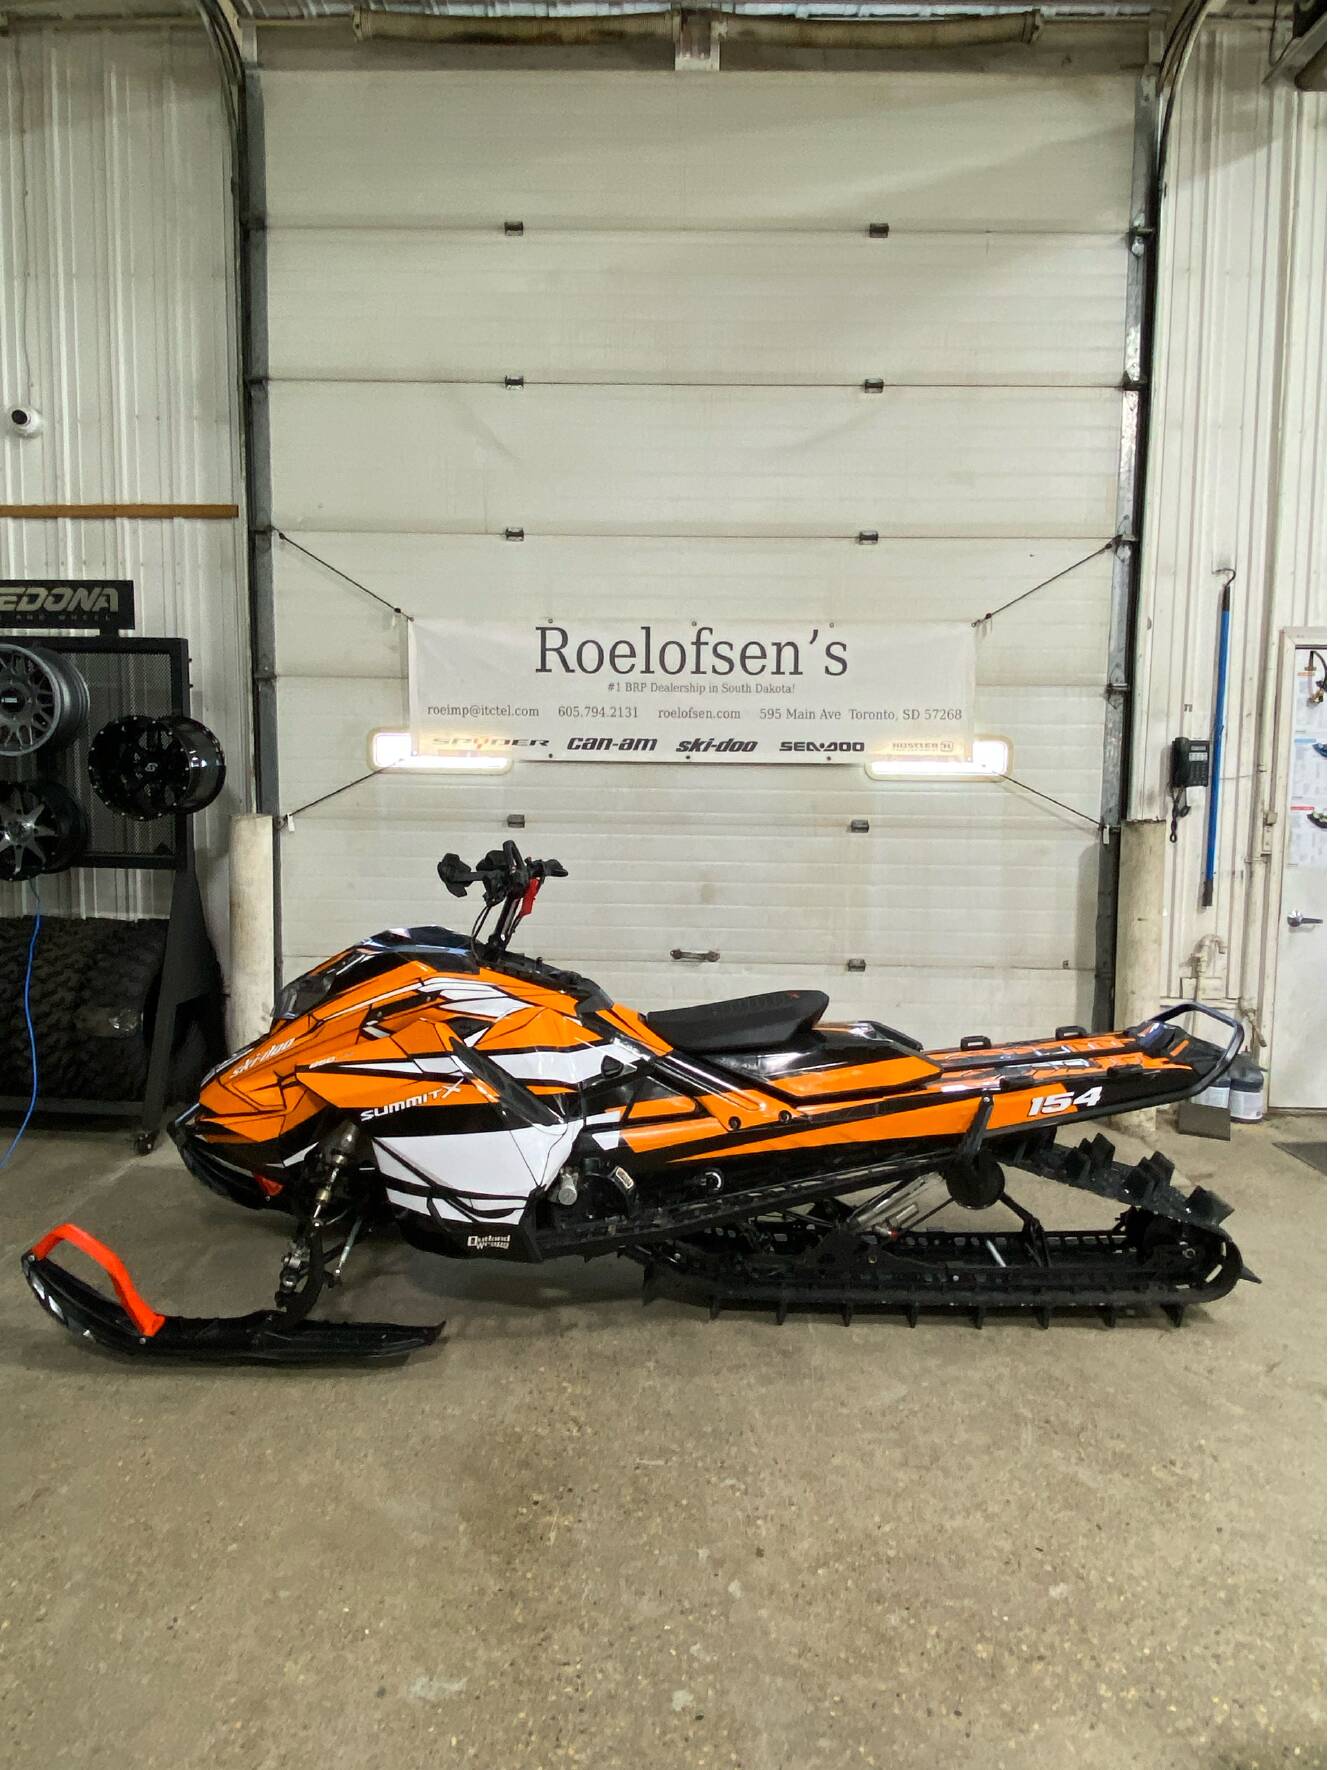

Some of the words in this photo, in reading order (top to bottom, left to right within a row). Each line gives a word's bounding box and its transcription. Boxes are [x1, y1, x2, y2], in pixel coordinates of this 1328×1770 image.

[535, 626, 848, 676] Roelofsen's
[608, 683, 620, 692] #1
[625, 683, 647, 692] BRP
[650, 682, 706, 696] Dealership
[708, 683, 719, 694] in
[721, 683, 752, 694] South
[755, 683, 795, 695] Dakota!
[427, 704, 540, 719] roeimp@itctel.com
[558, 706, 638, 718] 605.794.2131
[657, 706, 741, 720] roelofsen.com
[759, 708, 782, 720] 595
[786, 708, 816, 720] Main
[819, 709, 841, 720] Ave
[849, 709, 898, 721] Toronto,
[902, 710, 921, 720] SD
[923, 709, 963, 721] 57268
[567, 737, 657, 752] can-am
[676, 737, 758, 753] ski-doo
[1028, 1086, 1103, 1117] 154
